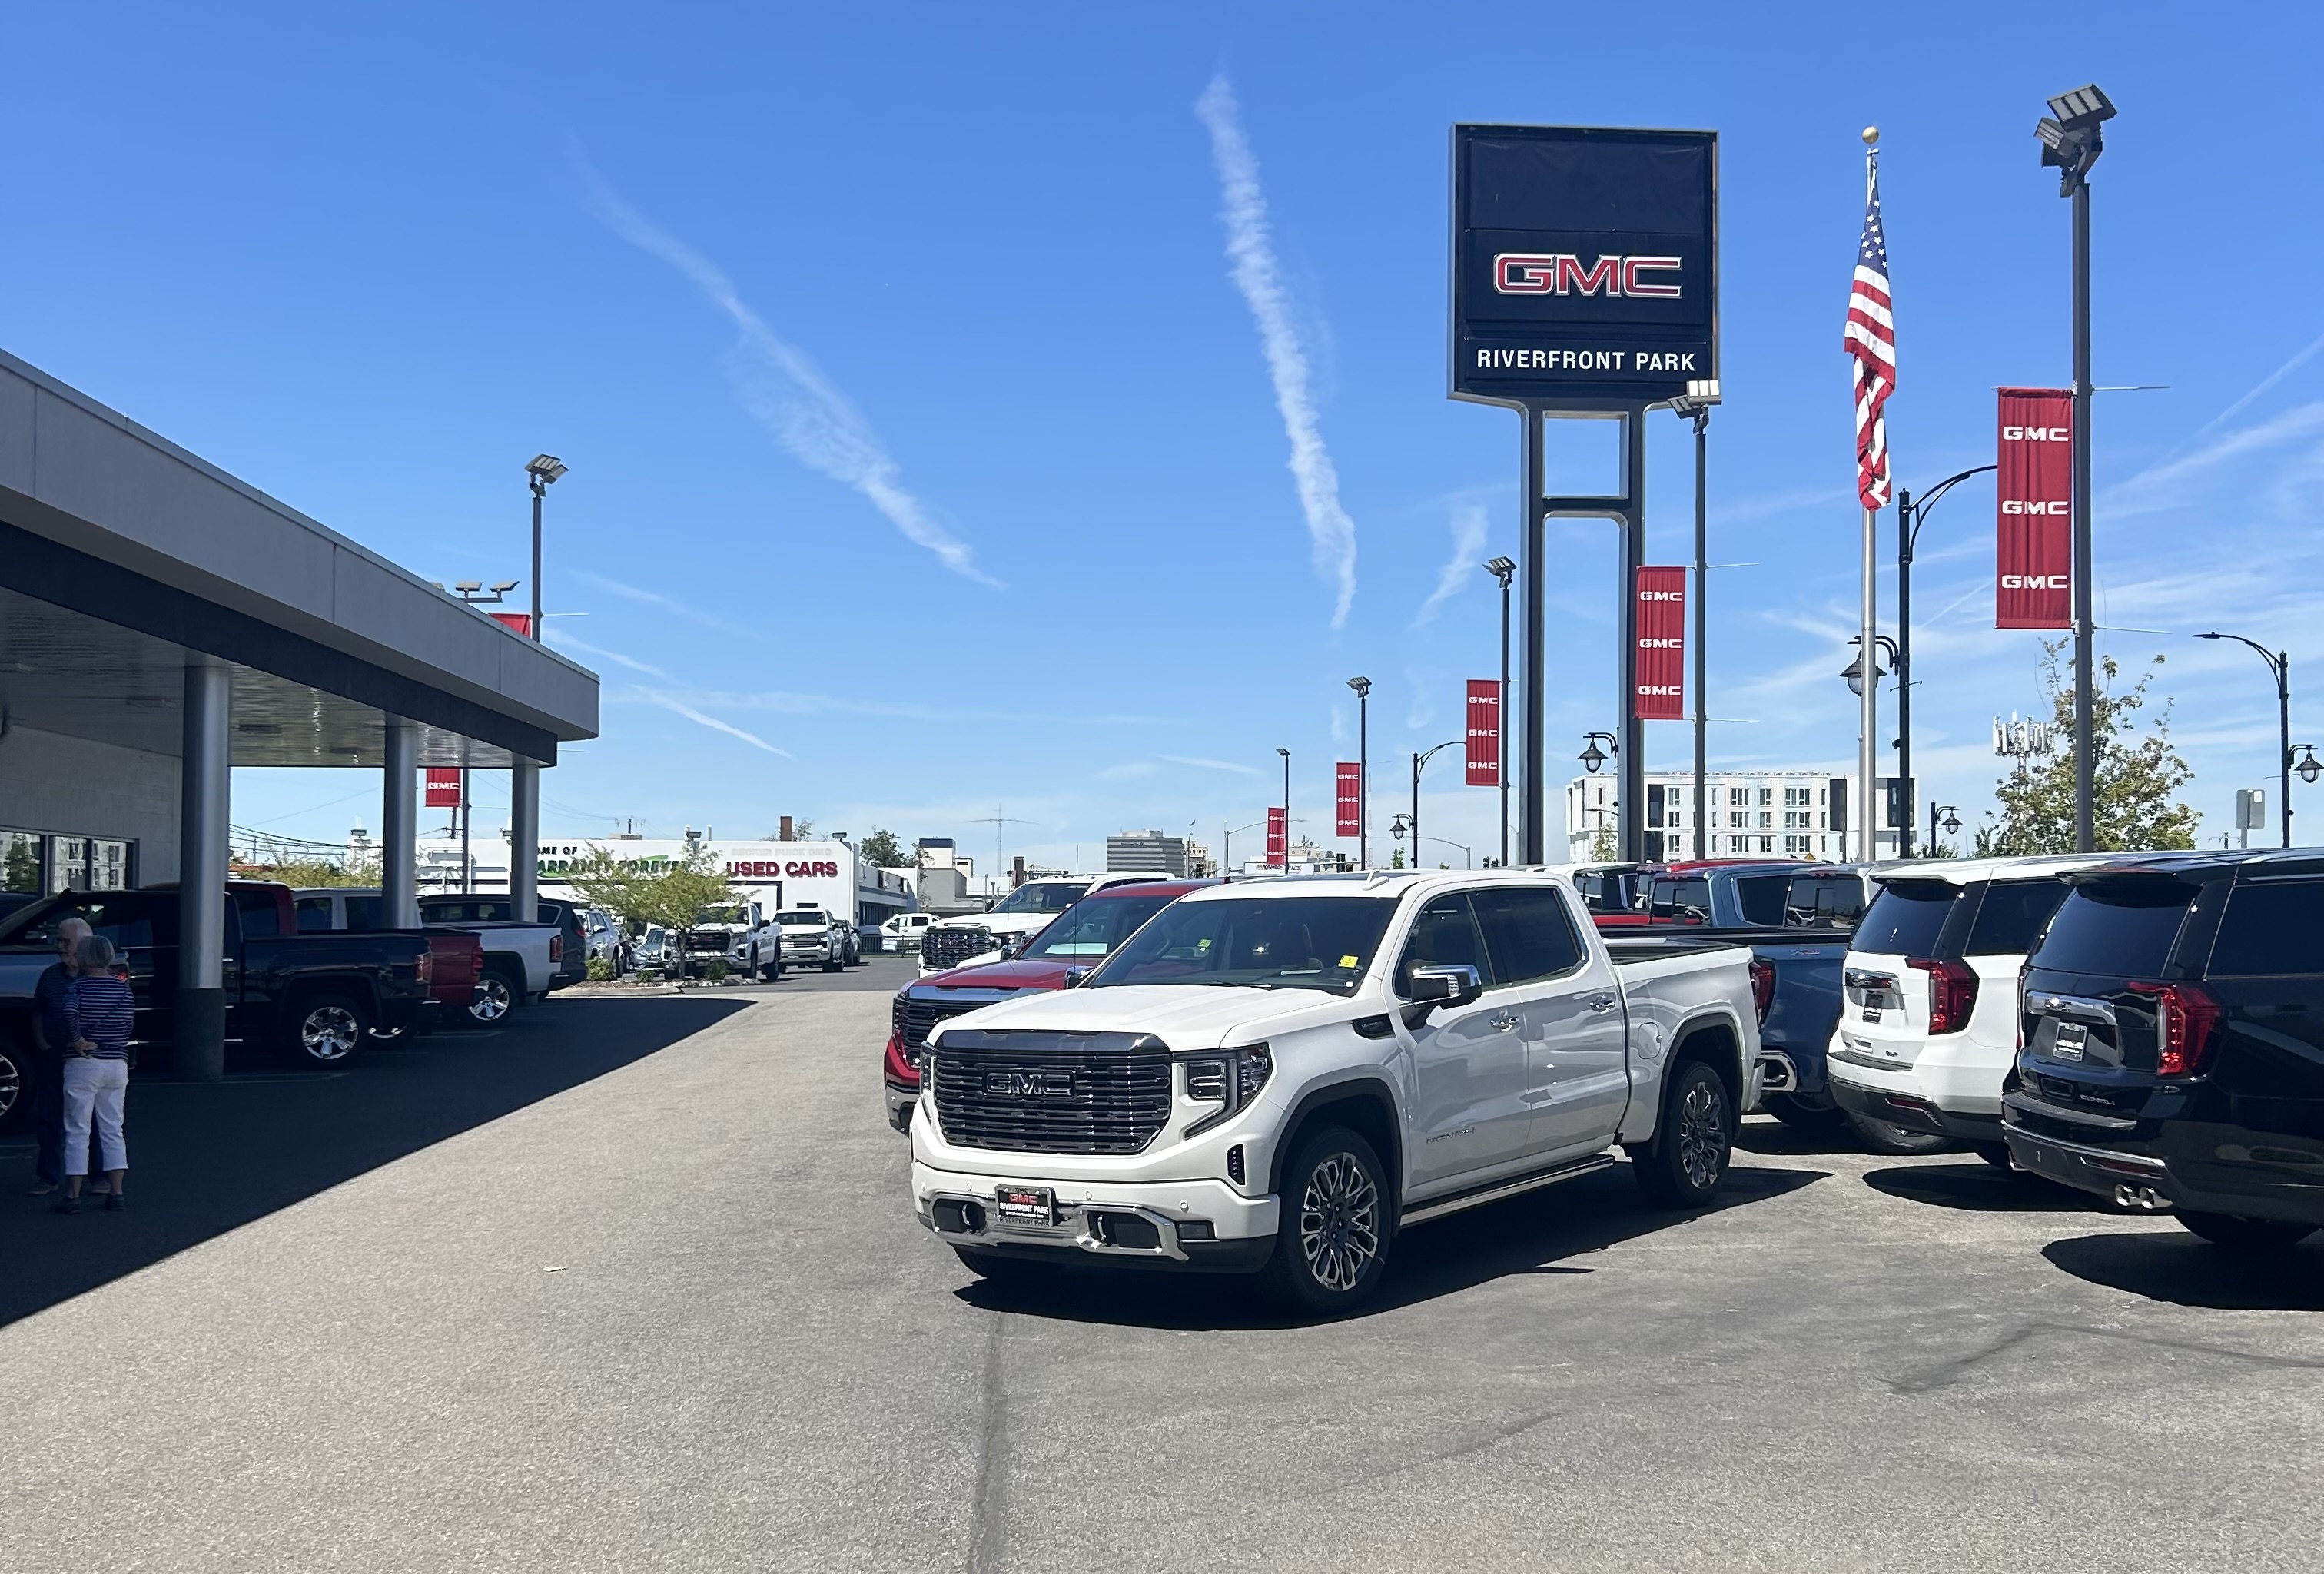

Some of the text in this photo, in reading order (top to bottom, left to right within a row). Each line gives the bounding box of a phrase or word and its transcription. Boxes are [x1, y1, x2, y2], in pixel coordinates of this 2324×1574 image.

[1493, 253, 1682, 299] GMC
[1476, 349, 1696, 372] RIVERFRONT PARK
[2002, 426, 2070, 442] GMC
[2001, 500, 2069, 515] GMC
[2001, 574, 2068, 589] GMC
[1640, 591, 1683, 602] GMC
[1639, 638, 1682, 649] GMC
[1638, 685, 1681, 696] GMC
[1468, 696, 1498, 705] GMC
[1468, 729, 1498, 737] GMC
[537, 846, 578, 855] ME OF
[775, 848, 805, 856] BUICK
[726, 862, 838, 878] USED CARS
[986, 1072, 1071, 1096] GMC
[1008, 1194, 1038, 1205] GMC
[1033, 1205, 1049, 1214] PARK
